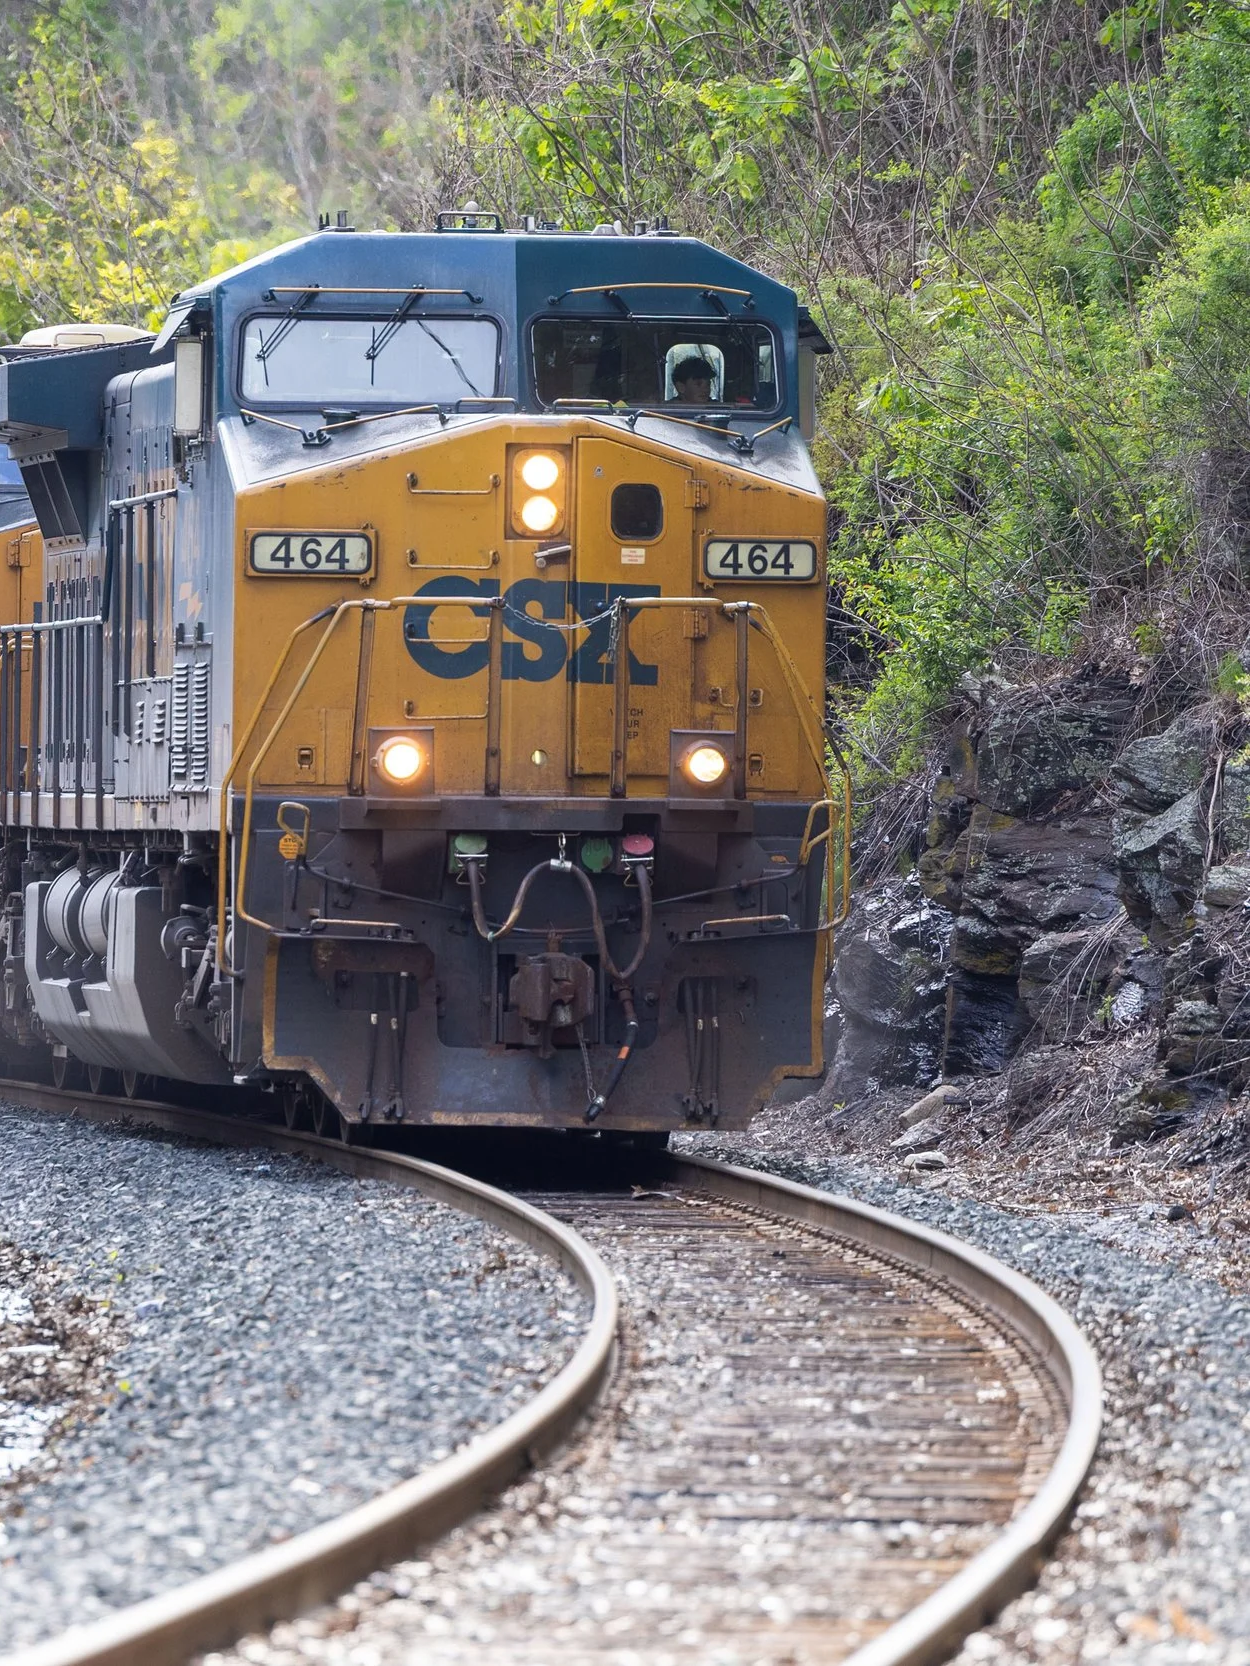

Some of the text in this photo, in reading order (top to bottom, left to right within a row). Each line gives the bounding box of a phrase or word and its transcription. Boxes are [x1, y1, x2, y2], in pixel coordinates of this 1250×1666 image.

[270, 537, 350, 570] 464
[719, 543, 795, 576] 464
[403, 575, 661, 686] CSX
